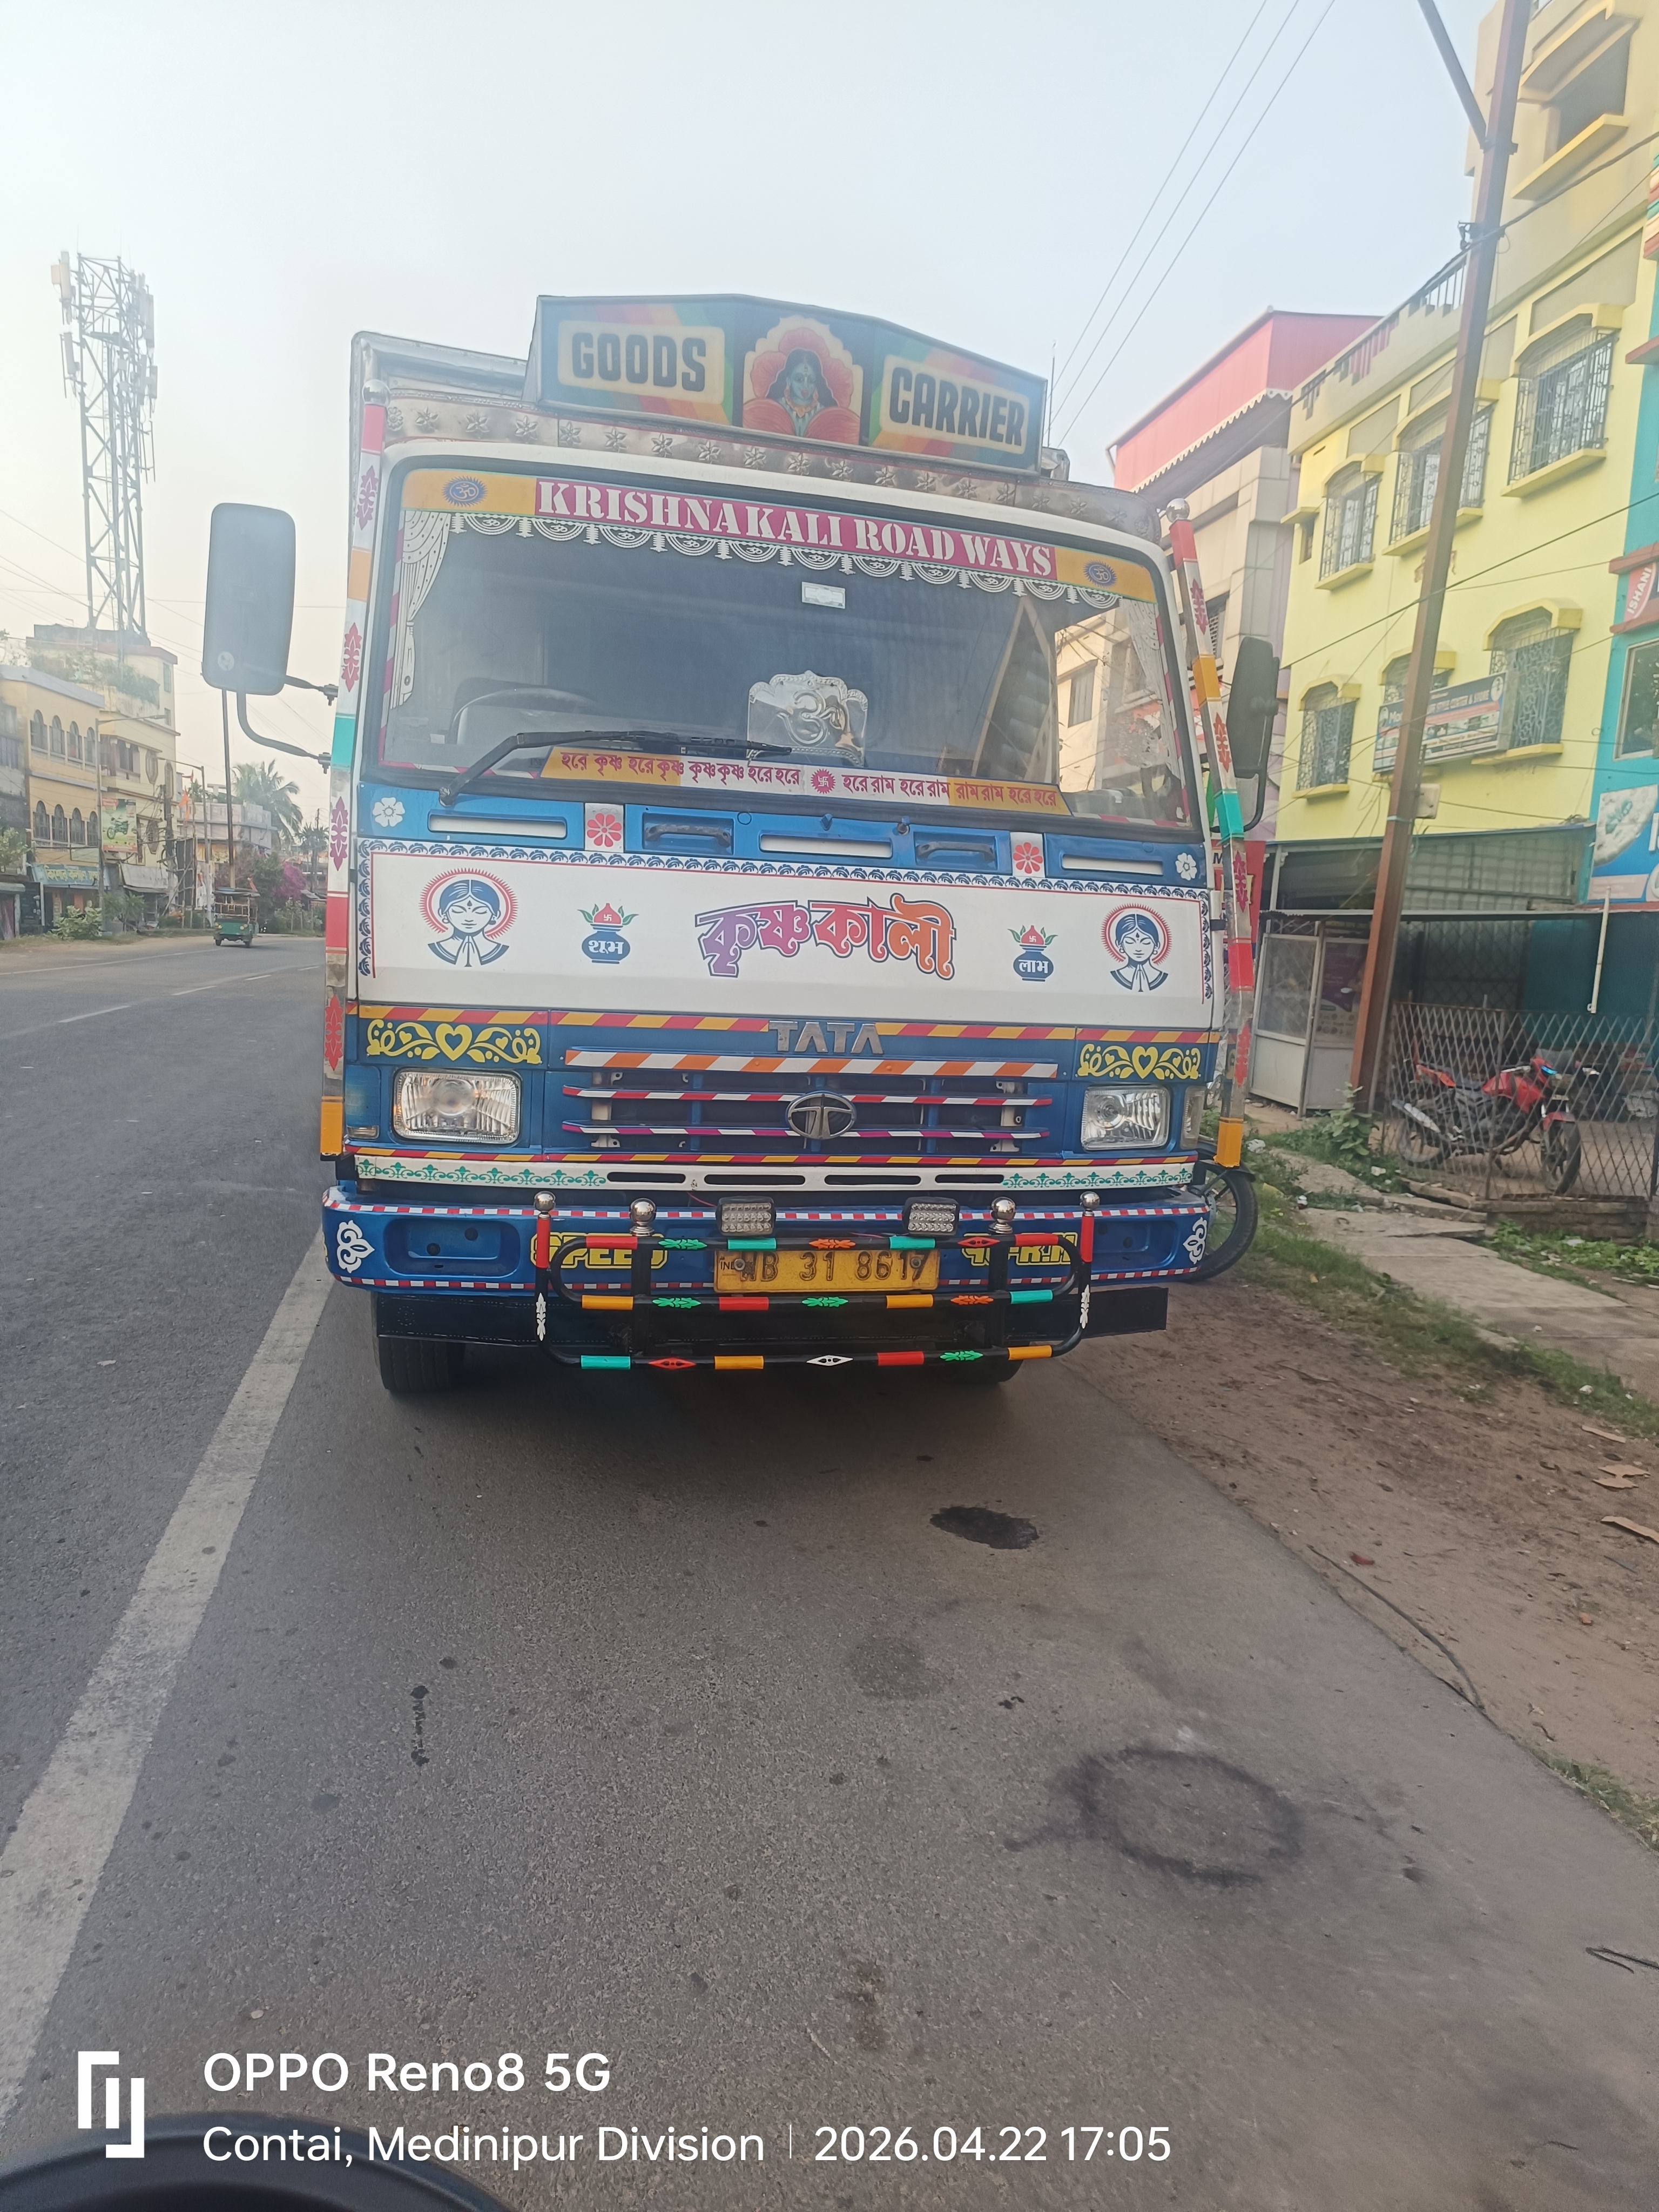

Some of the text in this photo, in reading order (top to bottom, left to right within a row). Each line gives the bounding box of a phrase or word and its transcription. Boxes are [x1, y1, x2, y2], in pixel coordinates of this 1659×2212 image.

[571, 332, 1025, 448] GOODS CARRIER
[538, 481, 842, 547] KRISHNAKALI
[1627, 567, 1652, 614] ISHANI
[561, 752, 588, 771] হরে
[1018, 960, 1048, 974] लाभ
[768, 1021, 884, 1054] TATA
[799, 1251, 834, 1281] 31
[856, 1250, 930, 1282] 8617
